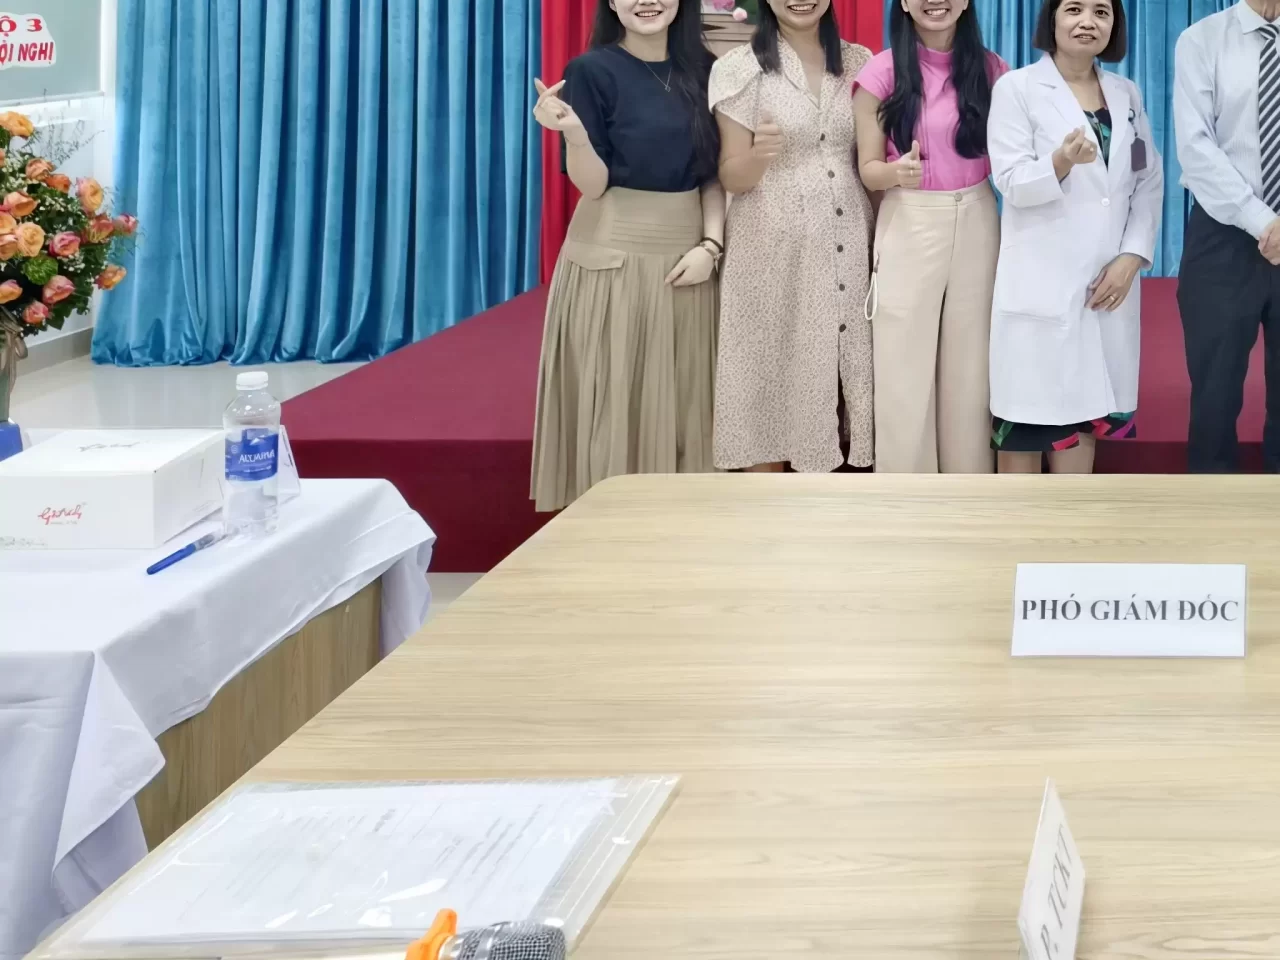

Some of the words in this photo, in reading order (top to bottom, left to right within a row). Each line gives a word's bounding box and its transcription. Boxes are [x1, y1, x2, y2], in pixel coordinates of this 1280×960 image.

[26, 18, 42, 32] 3
[1022, 593, 1082, 621] PHÓ
[1090, 593, 1168, 621] GIÁM
[1177, 593, 1239, 621] ĐỐC
